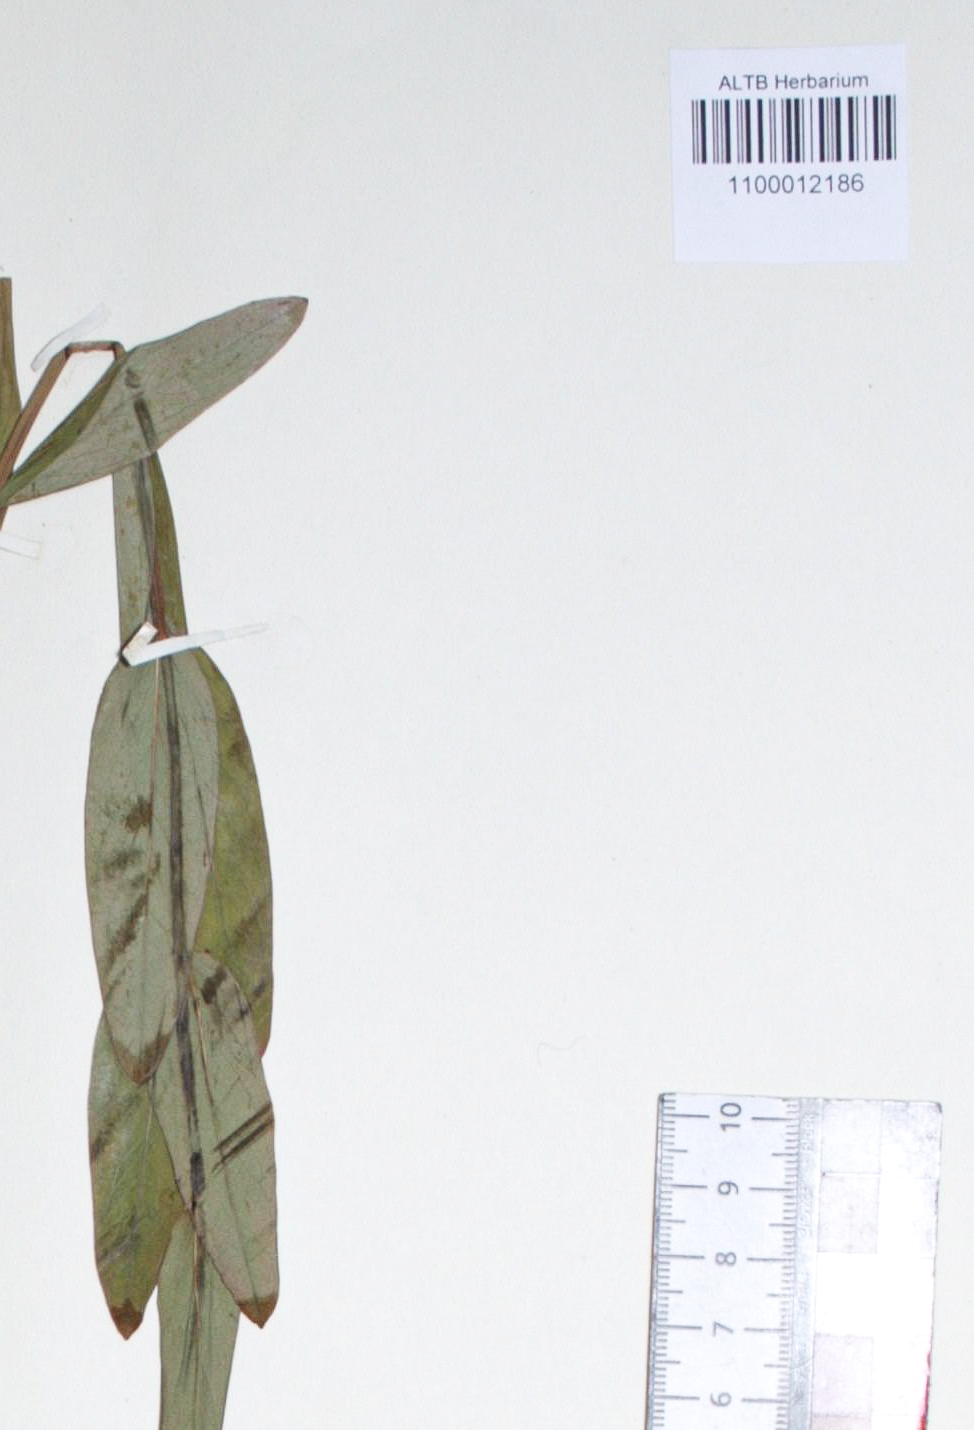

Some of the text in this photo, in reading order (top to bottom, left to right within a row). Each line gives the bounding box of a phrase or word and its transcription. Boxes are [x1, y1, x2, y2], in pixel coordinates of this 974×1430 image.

[718, 72, 869, 91] ALTB Herbarium
[728, 173, 865, 194] 1100012186
[720, 1102, 742, 1132] 10
[717, 1181, 739, 1196] 9
[715, 1251, 737, 1267] 8
[713, 1321, 734, 1336] 7
[710, 1392, 732, 1407] 6
